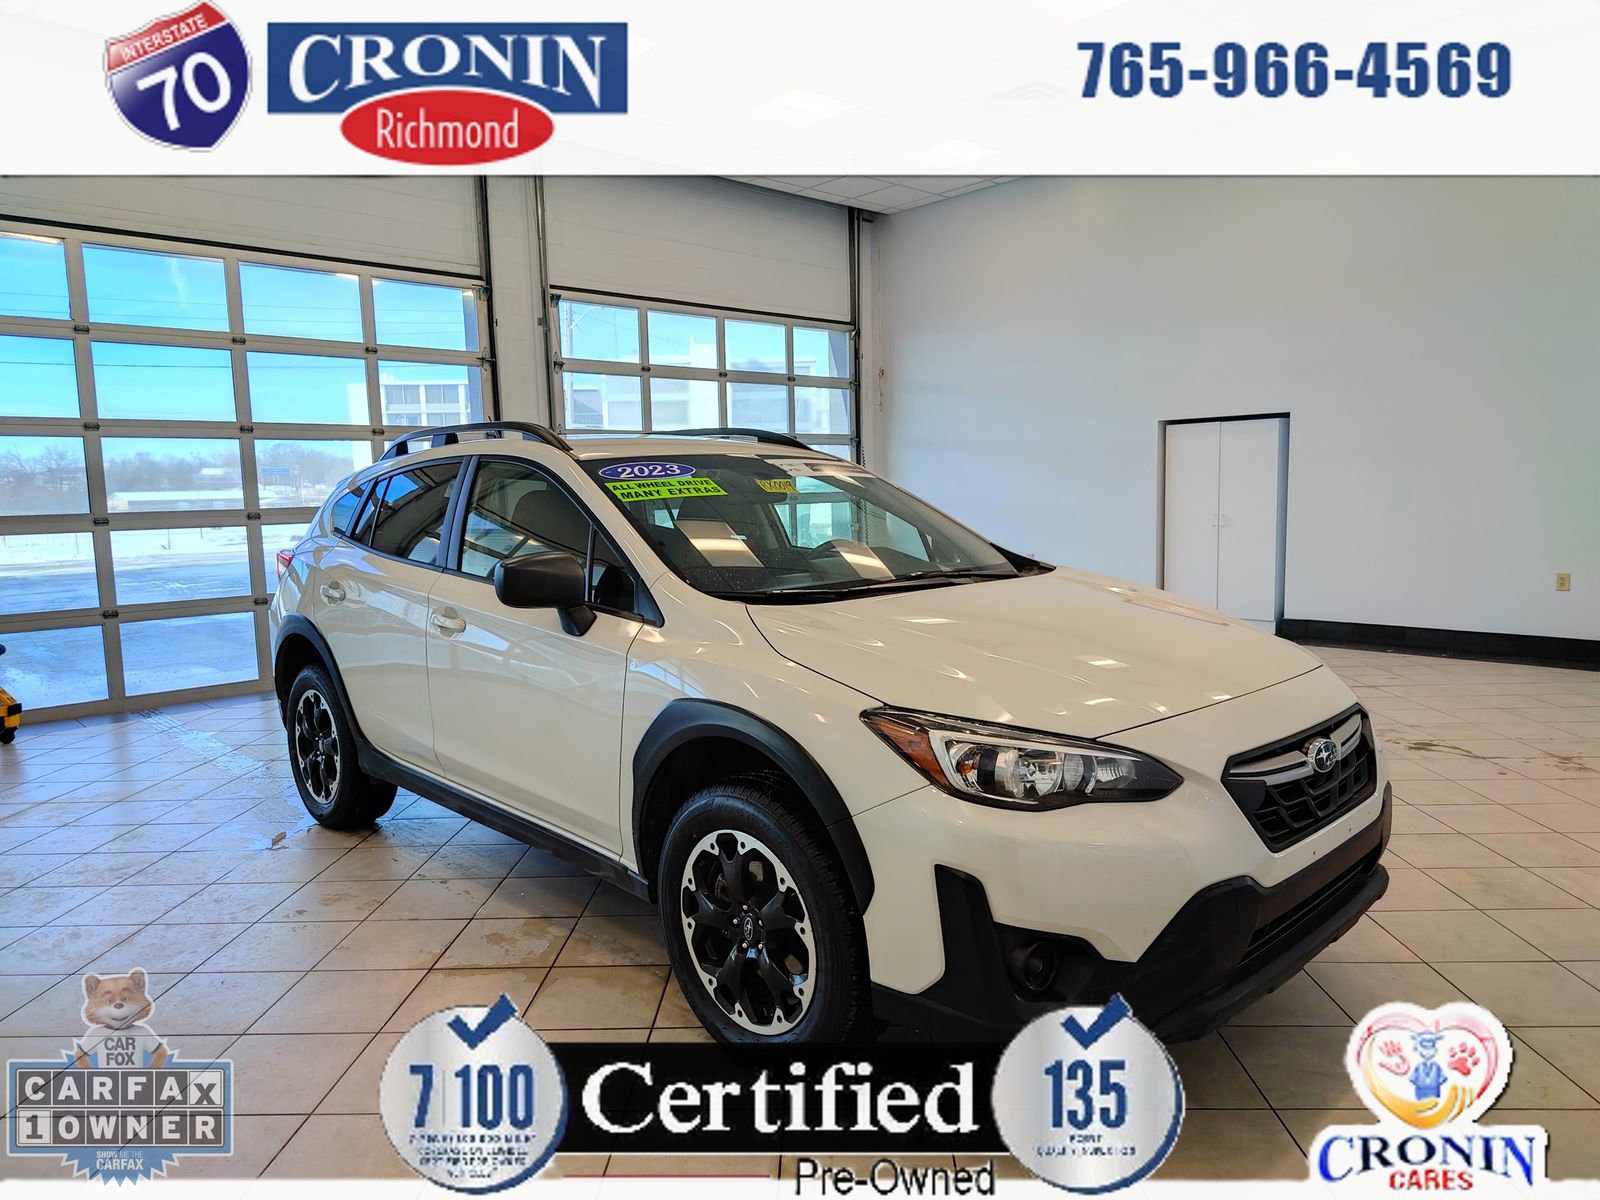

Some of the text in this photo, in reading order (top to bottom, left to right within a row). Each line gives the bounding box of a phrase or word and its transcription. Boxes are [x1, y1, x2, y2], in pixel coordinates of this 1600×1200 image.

[617, 464, 681, 478] 2023
[612, 479, 711, 491] ALL WHEEL DRIVE
[620, 487, 721, 500] MANY EXTRAS
